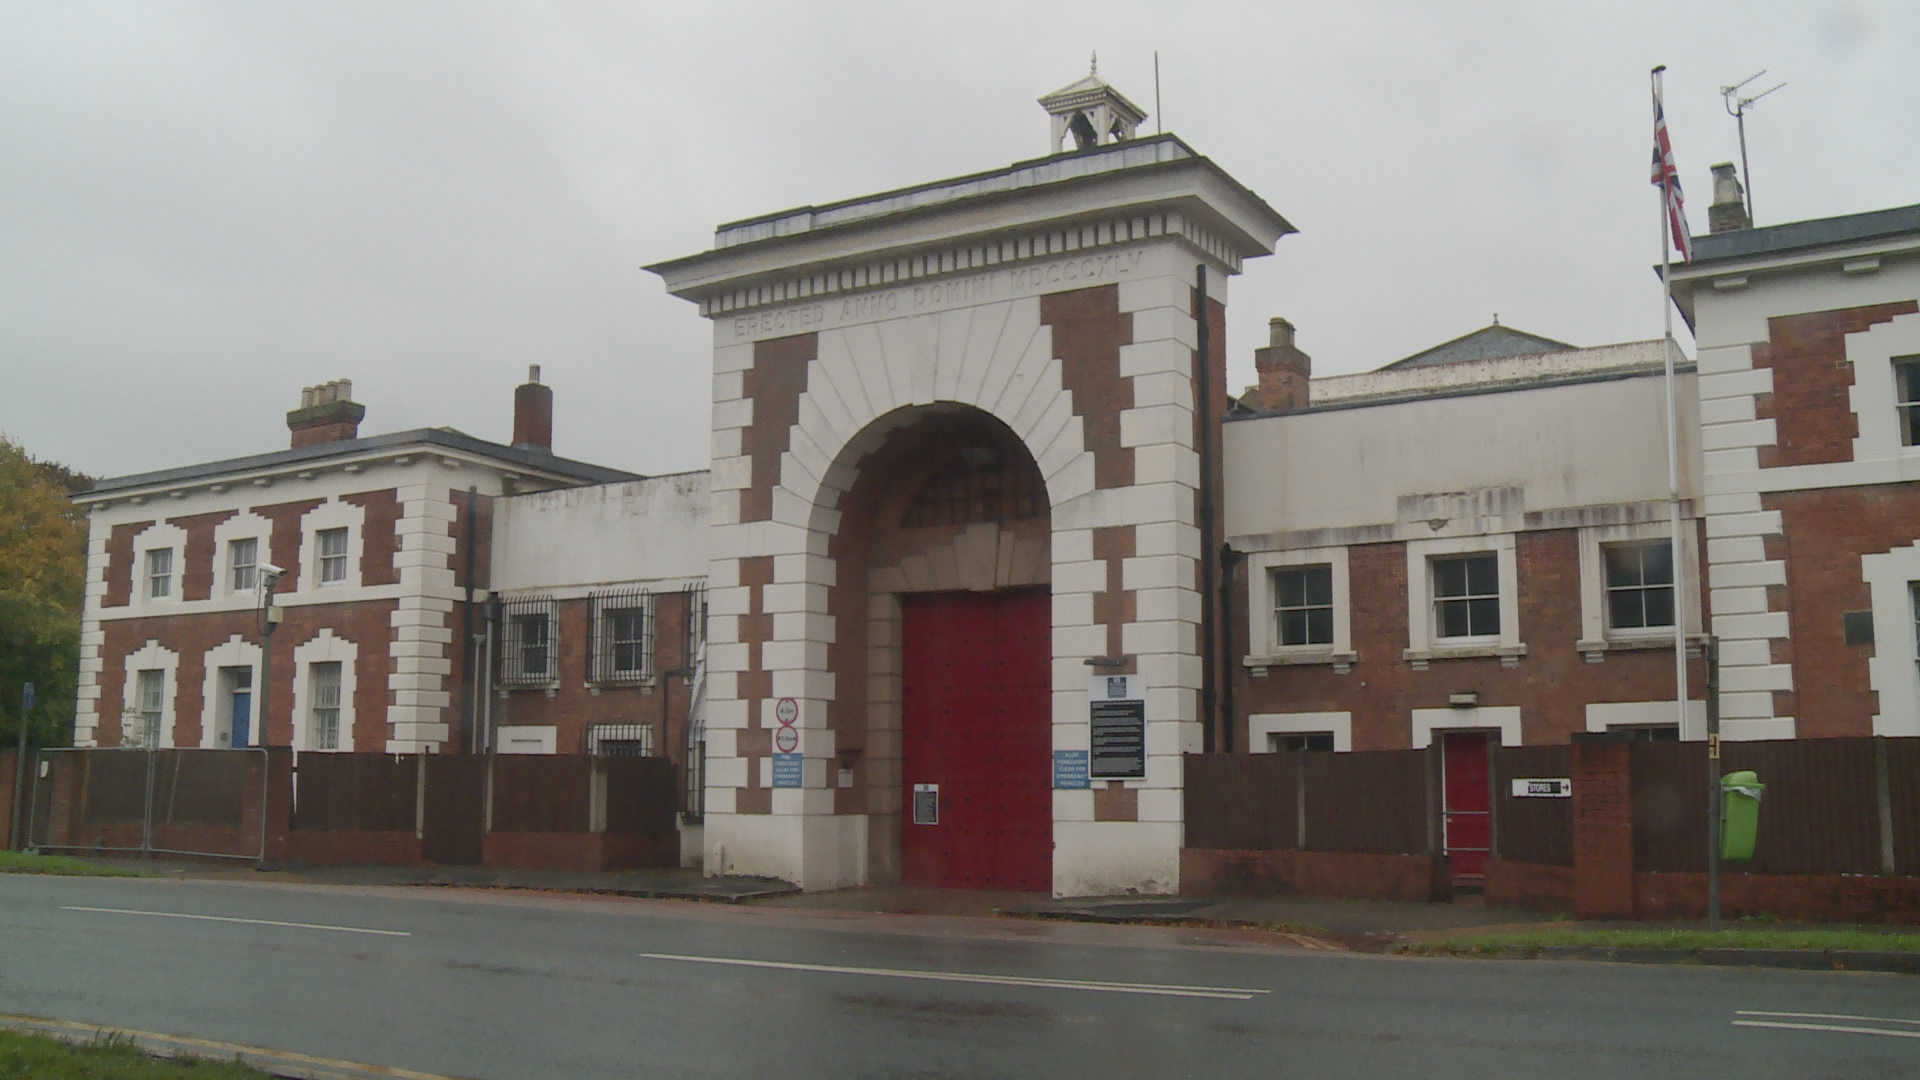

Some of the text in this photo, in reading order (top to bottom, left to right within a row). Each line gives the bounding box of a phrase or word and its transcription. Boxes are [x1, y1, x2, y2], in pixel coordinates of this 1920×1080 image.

[734, 251, 1144, 337] ERECTED ANNO DOMINI MDCCCXLV
[1530, 783, 1551, 792] STORES
